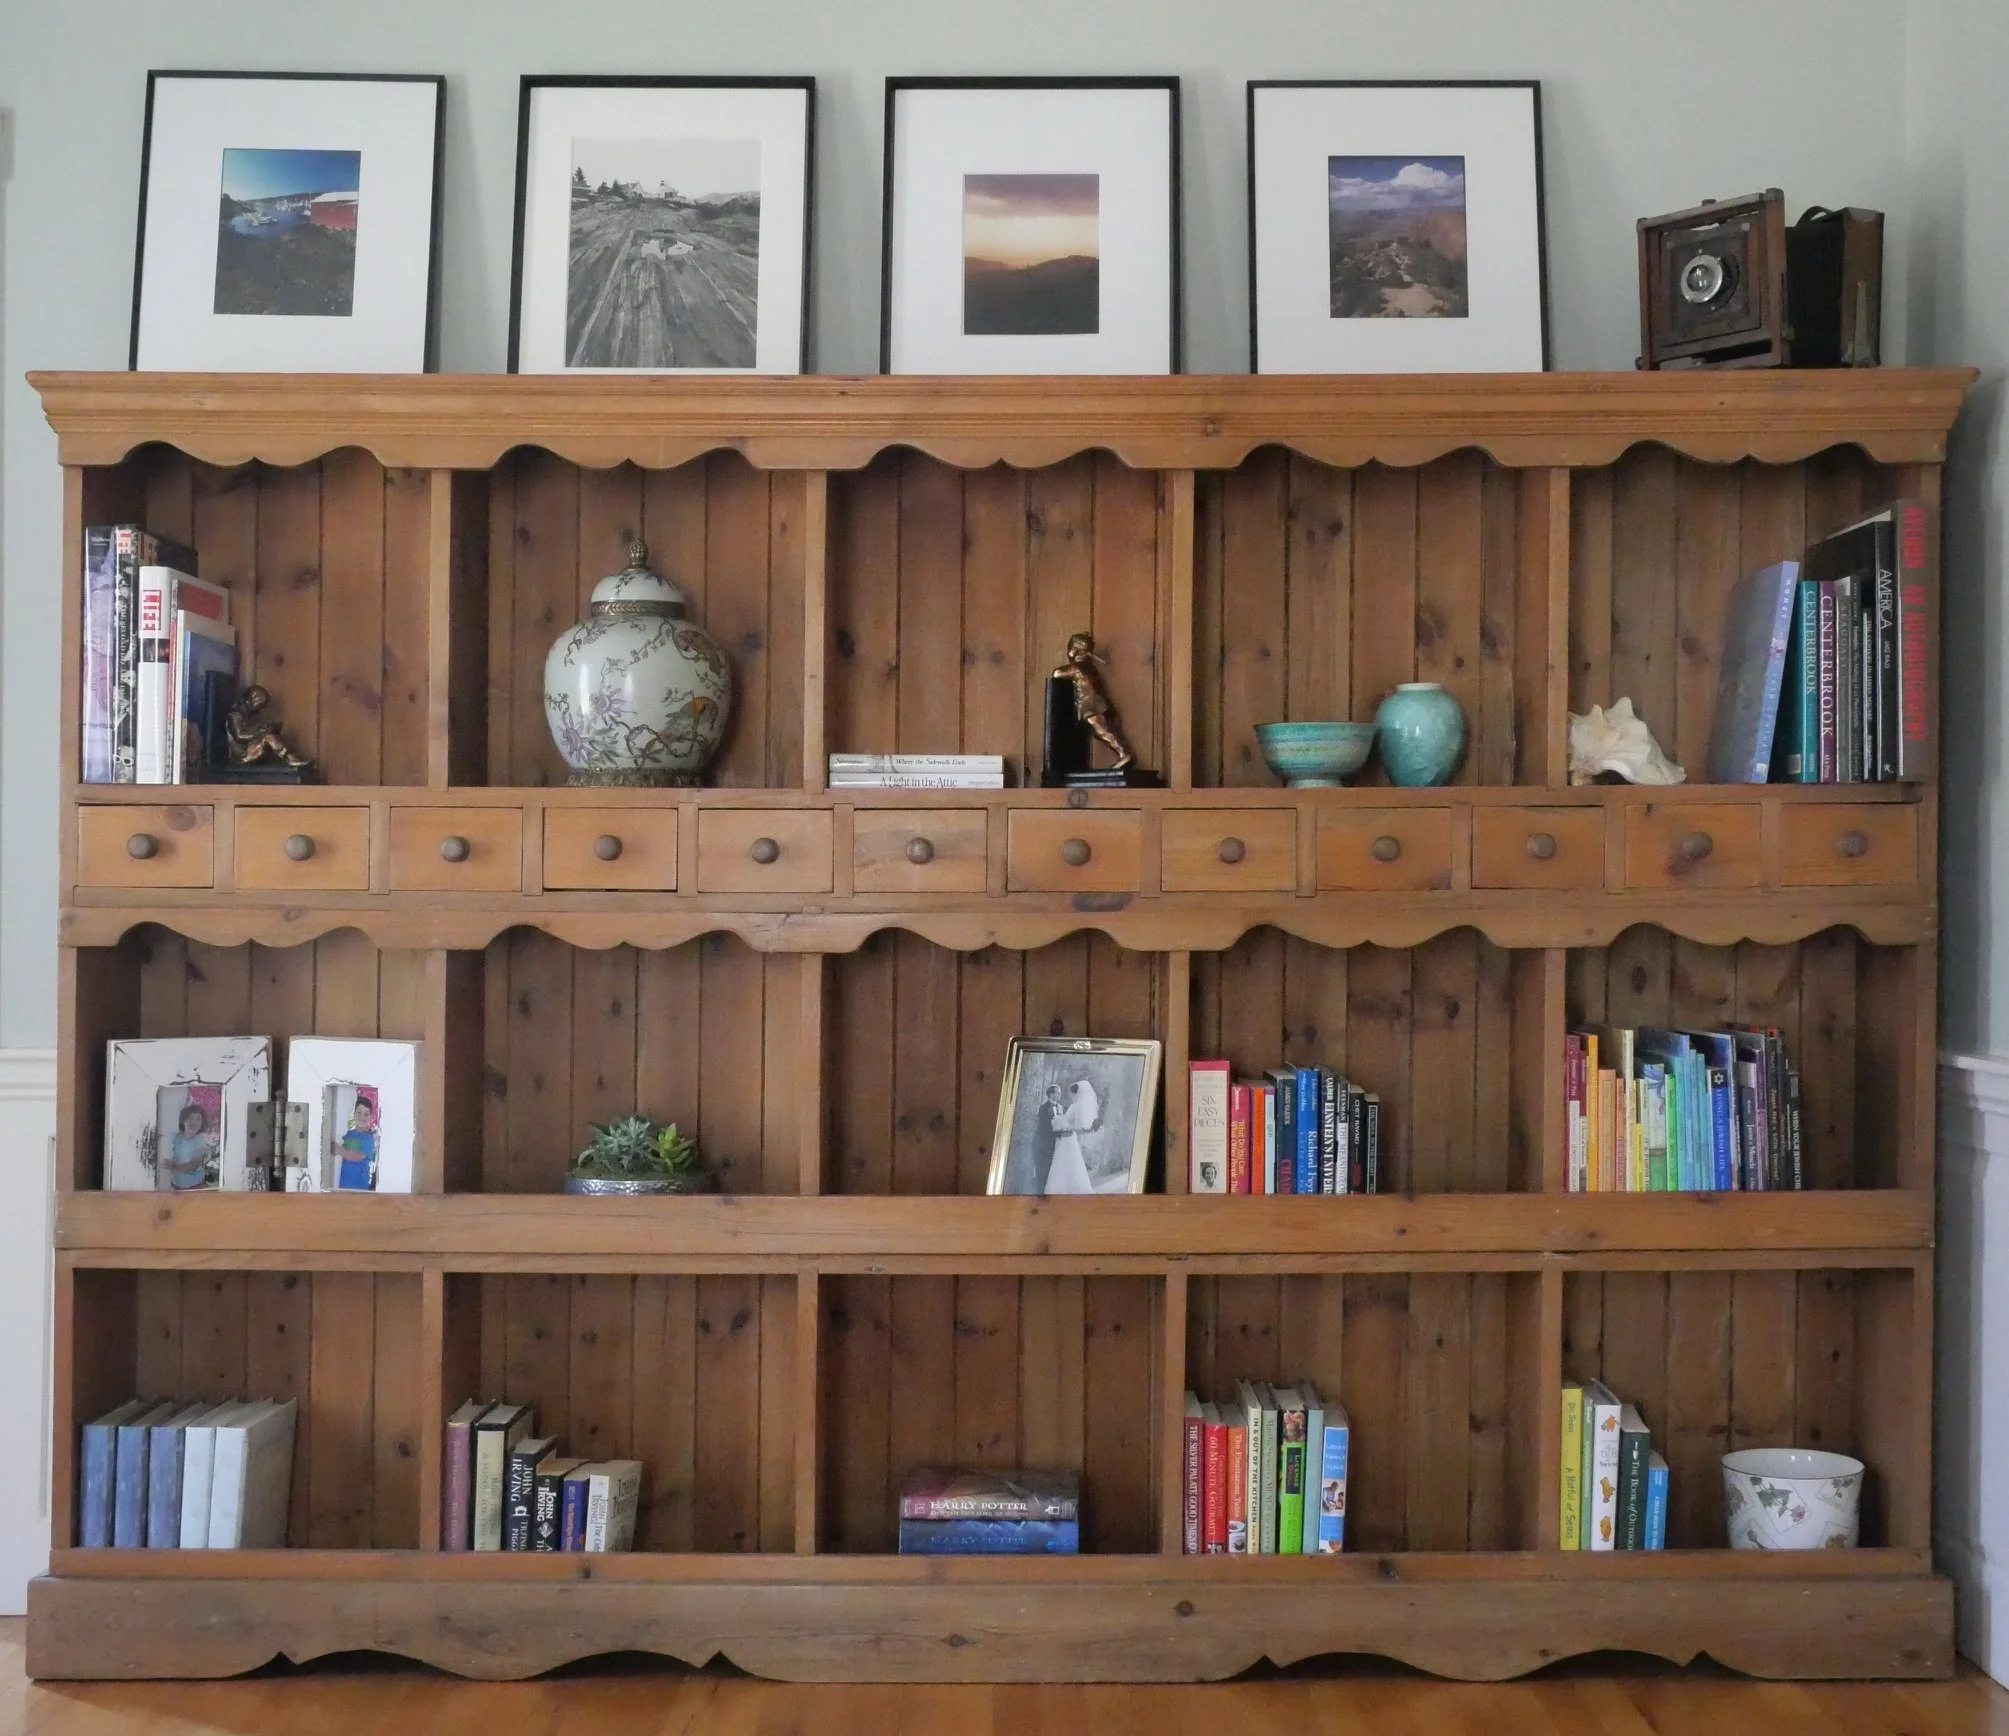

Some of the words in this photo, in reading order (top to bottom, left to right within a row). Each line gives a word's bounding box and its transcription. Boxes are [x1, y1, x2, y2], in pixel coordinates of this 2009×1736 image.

[1780, 577, 1792, 619] MONET
[1880, 568, 1893, 629] AMERICA
[142, 589, 162, 631] LIFE
[1806, 590, 1818, 696] CENTERBROOK
[1821, 595, 1834, 737] CENTERBROOK
[896, 758, 913, 766] Where
[916, 758, 925, 766] the
[880, 777, 888, 787] A
[889, 776, 910, 789] Light
[911, 777, 920, 787] in
[921, 777, 936, 787] the
[936, 777, 959, 788] Attic
[1201, 1095, 1217, 1105] SIX
[1339, 1089, 1348, 1122] FEYNMAN
[1197, 1107, 1218, 1116] EASY
[1193, 1118, 1225, 1128] PIECES
[1324, 1102, 1337, 1154] EINSTEIN'S
[1338, 1126, 1348, 1142] THE
[1793, 1131, 1801, 1151] YOUR
[1308, 1130, 1319, 1168] Richard
[1338, 1143, 1348, 1178] MEANING
[1568, 1402, 1577, 1413] Dr.
[1253, 1417, 1260, 1427] IN
[1253, 1428, 1259, 1436] &
[1567, 1415, 1577, 1433] Seuss
[1190, 1426, 1199, 1440] THE
[1234, 1434, 1243, 1450] The
[1190, 1441, 1199, 1466] SILVER
[1252, 1436, 1260, 1453] OUT
[1252, 1456, 1259, 1466] OF
[1630, 1460, 1640, 1476] THE
[511, 1458, 523, 1502] IRVING
[522, 1464, 534, 1495] JOHN
[1189, 1467, 1199, 1494] PALATE
[1567, 1476, 1576, 1500] Hatful
[1629, 1479, 1640, 1501] BOOK
[536, 1486, 550, 1522] IRVING
[545, 1491, 557, 1519] JOHN
[590, 1495, 602, 1523] IRVING
[598, 1499, 609, 1520] JOHN
[930, 1501, 977, 1511] HARRY
[980, 1502, 1028, 1511] POTTER
[1190, 1496, 1199, 1519] GOOD
[1208, 1490, 1219, 1537] GOURMET
[1234, 1497, 1242, 1518] Table
[1251, 1486, 1259, 1524] KITCHEN
[1565, 1502, 1573, 1512] of
[1627, 1503, 1638, 1515] of
[594, 1525, 603, 1537] The
[1189, 1519, 1199, 1542] TIMES
[1565, 1515, 1576, 1539] Seuss
[930, 1536, 977, 1544] HARRY
